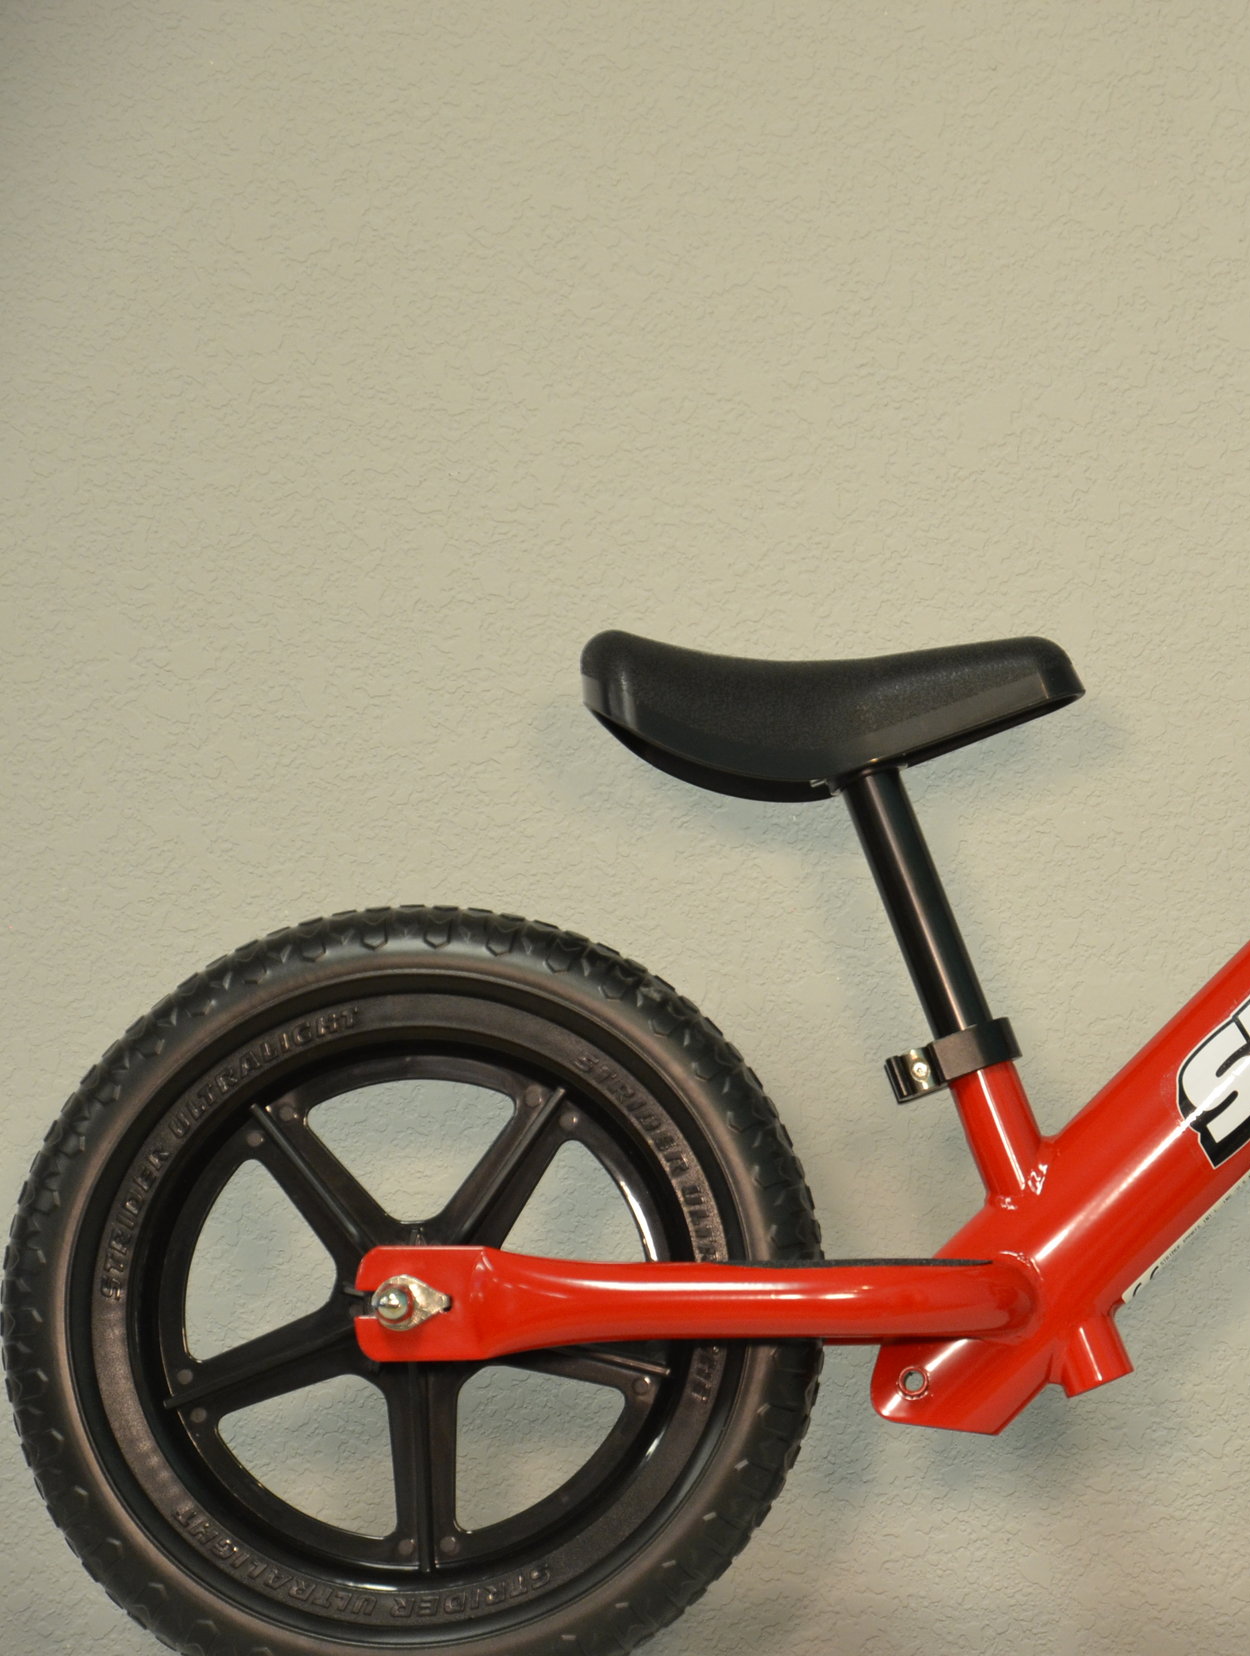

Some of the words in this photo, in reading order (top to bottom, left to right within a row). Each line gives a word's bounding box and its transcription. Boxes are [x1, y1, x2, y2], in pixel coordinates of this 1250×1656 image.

[101, 1141, 171, 1300] STRIDER
[166, 1006, 362, 1139] ULTRALIGHT
[572, 1049, 690, 1177] STRIDER
[175, 1502, 376, 1620] ULTRALIGHT
[391, 1564, 554, 1618] STRIDER
